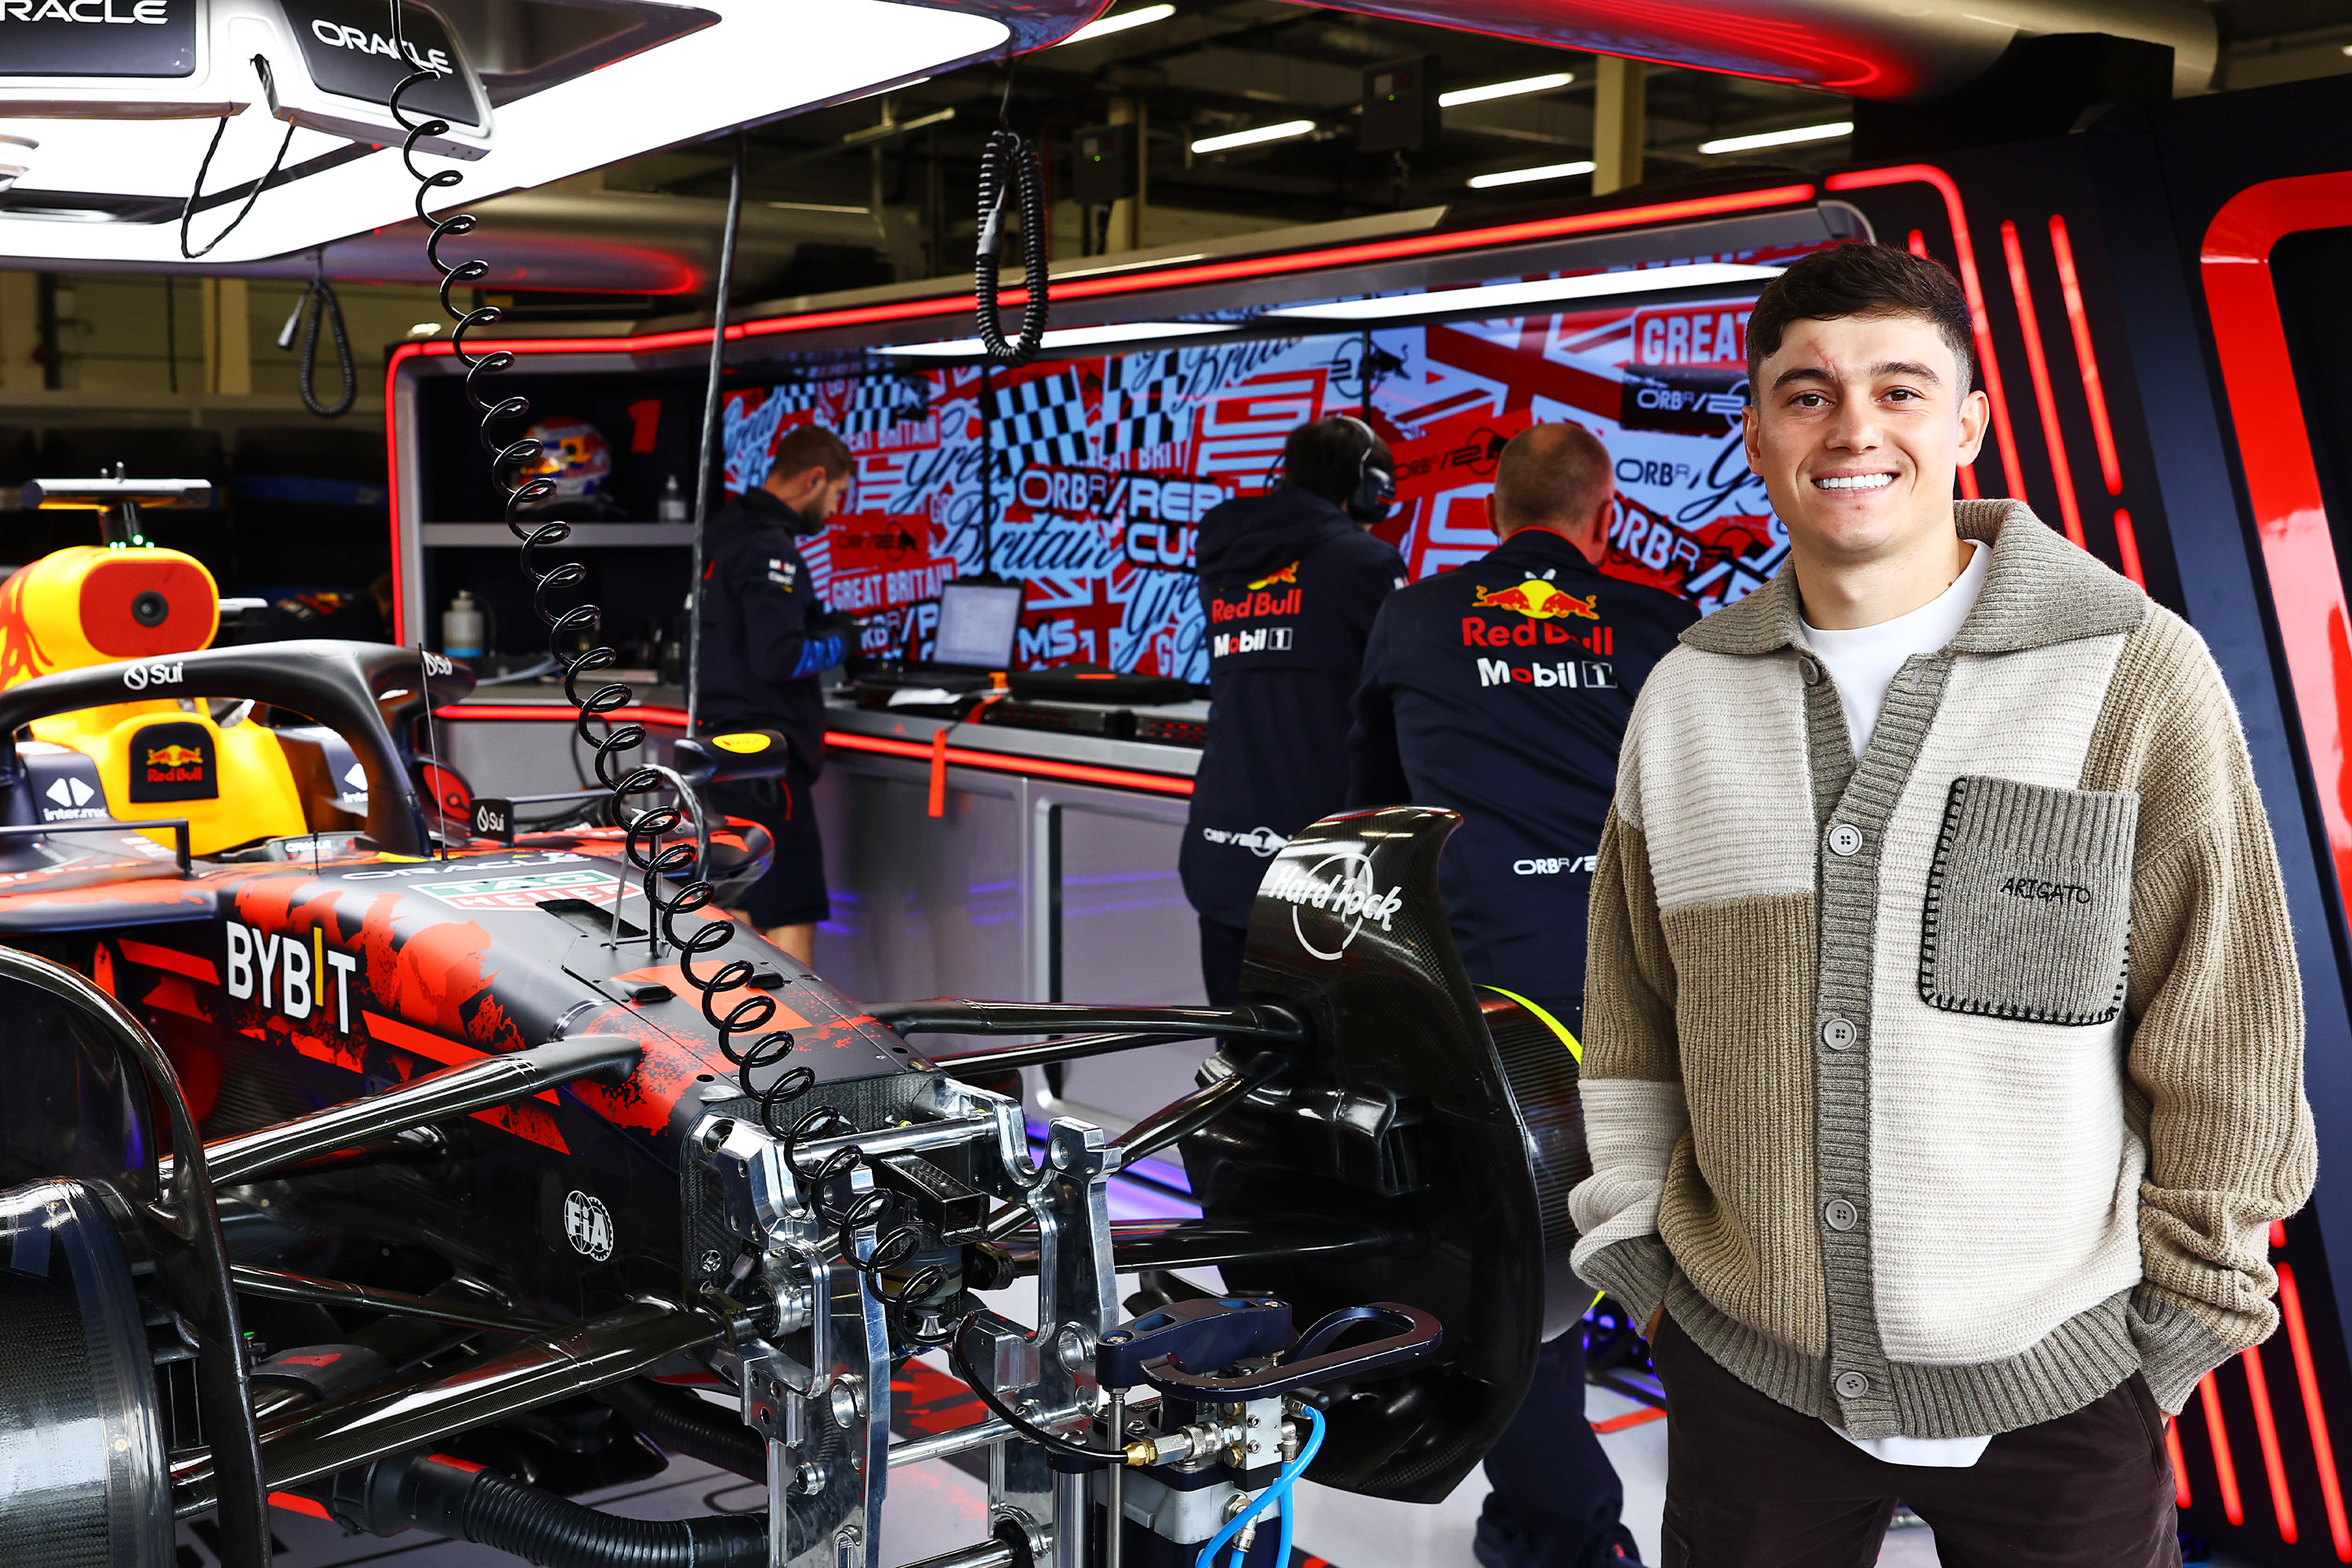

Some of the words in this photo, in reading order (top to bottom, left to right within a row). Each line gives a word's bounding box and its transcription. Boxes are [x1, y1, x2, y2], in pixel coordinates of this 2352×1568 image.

[627, 399, 662, 453] 1
[1211, 592, 1254, 624] Red
[1254, 589, 1302, 616] Bull
[1214, 628, 1267, 659] Mobil
[1461, 617, 1537, 647] Red
[151, 661, 183, 684] Sui
[1477, 657, 1577, 688] Mobil
[147, 768, 175, 782] Red
[176, 766, 203, 781] Bull
[431, 873, 599, 894] TAG
[1269, 865, 1342, 909] Hard
[1331, 877, 1403, 931] Rock
[2000, 877, 2091, 903] ARIGATO
[226, 920, 356, 1034] BYBIT
